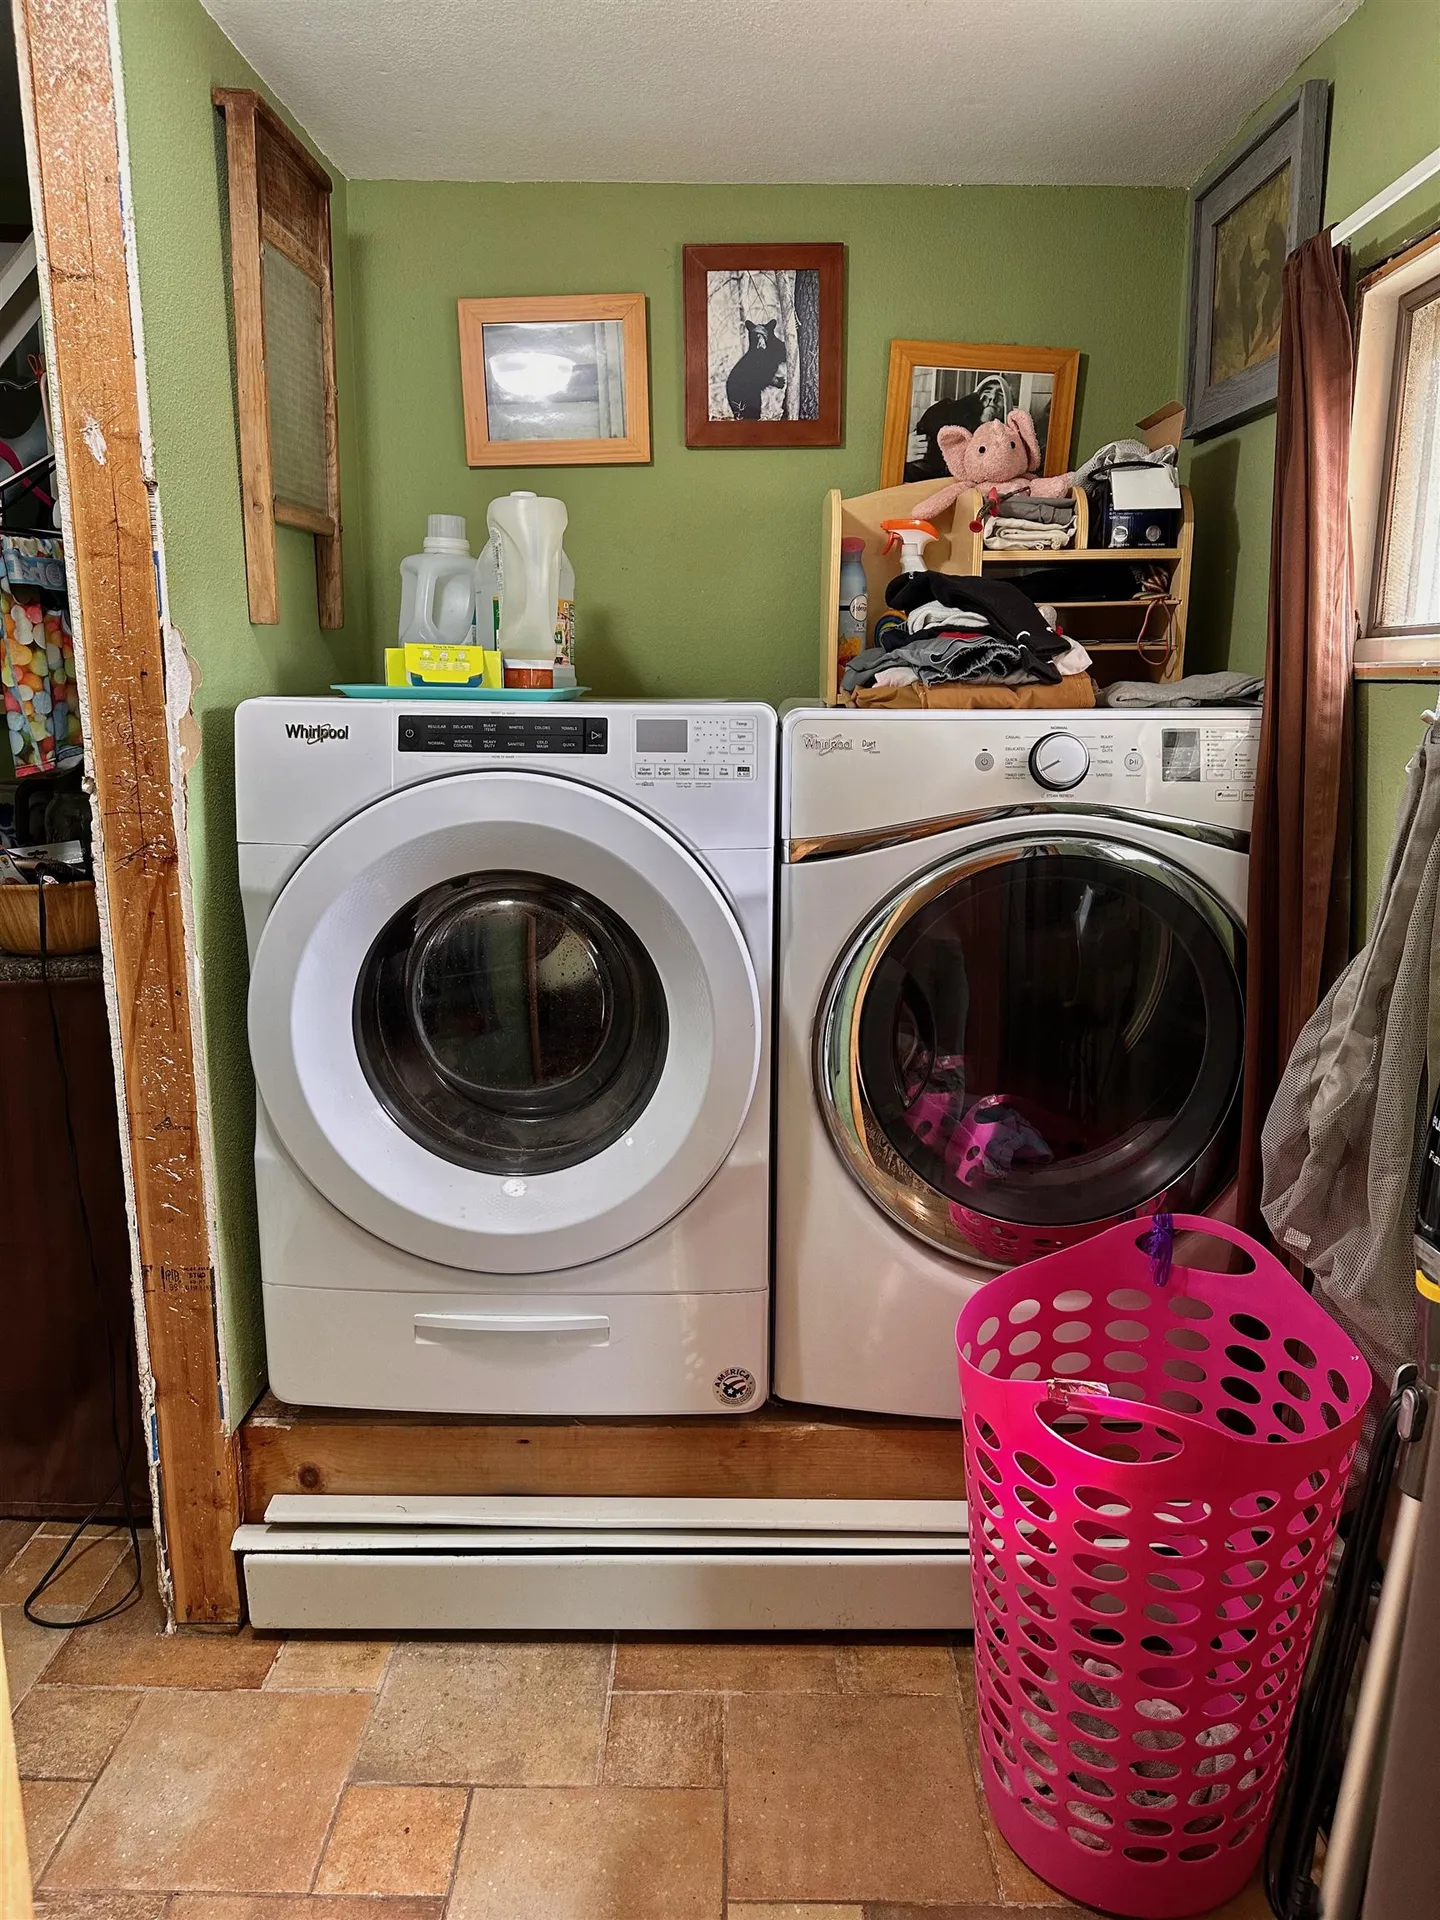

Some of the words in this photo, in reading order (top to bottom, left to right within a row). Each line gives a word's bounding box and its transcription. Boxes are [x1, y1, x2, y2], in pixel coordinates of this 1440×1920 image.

[285, 724, 349, 743] Whirlpool
[803, 736, 853, 754] Whirlpool
[714, 1368, 750, 1388] AMERICA
